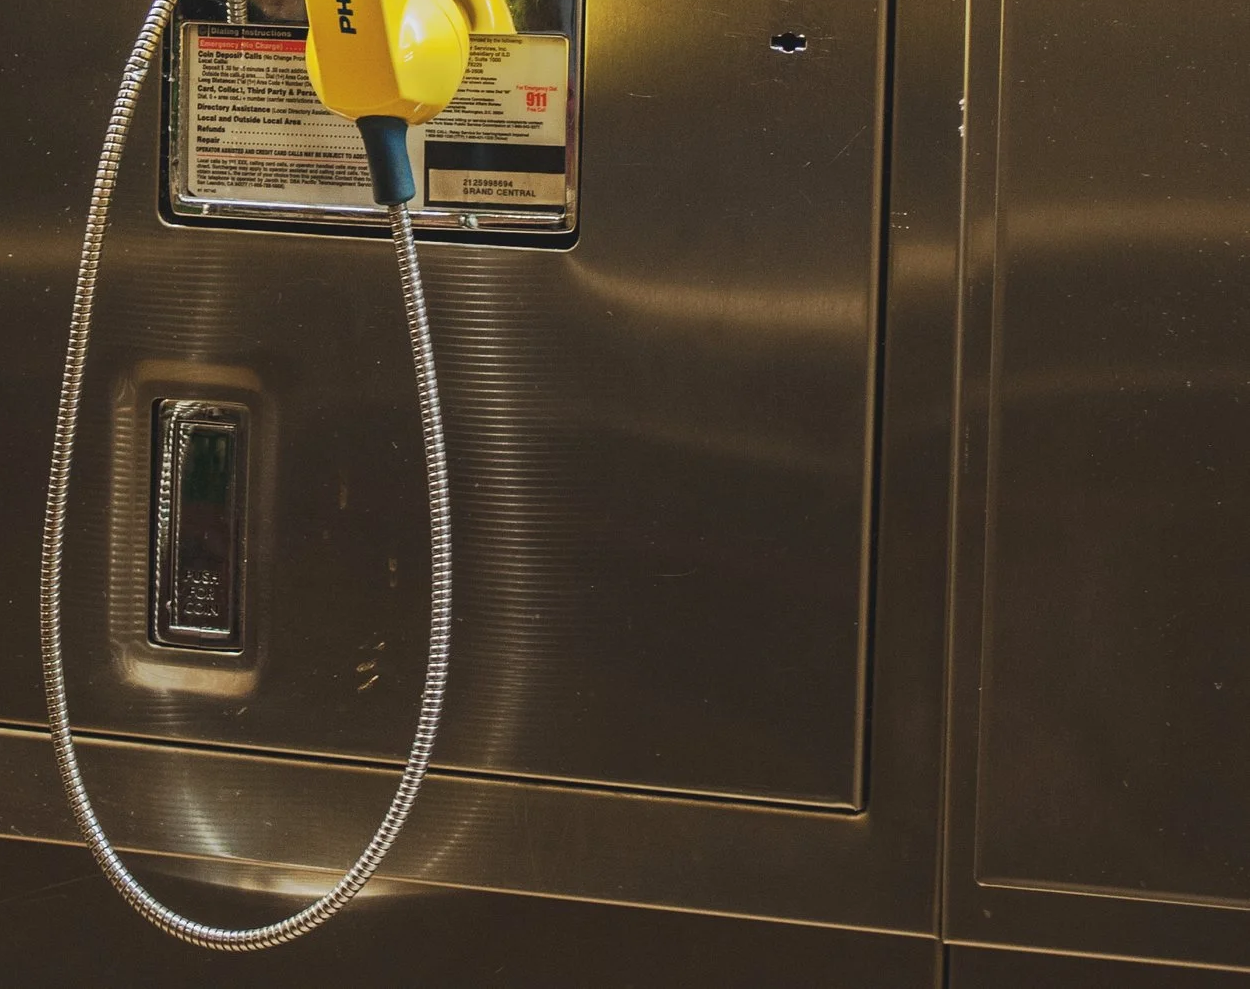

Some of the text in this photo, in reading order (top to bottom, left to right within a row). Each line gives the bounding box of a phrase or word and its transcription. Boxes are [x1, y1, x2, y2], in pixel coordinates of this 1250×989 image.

[211, 27, 291, 37] Dialing Instructions
[200, 40, 239, 49] Emergency
[216, 51, 242, 59] Deposit
[198, 85, 216, 93] Card,
[218, 86, 245, 94] Collect,
[267, 88, 286, 97] Party
[526, 92, 547, 106] 911
[197, 103, 230, 112] Directory
[231, 105, 270, 113] Assistance
[197, 136, 220, 144] Repair
[496, 189, 536, 197] CENTRAL
[184, 570, 219, 585] PUSH
[188, 587, 214, 600] FOR
[184, 602, 219, 616] COIN
